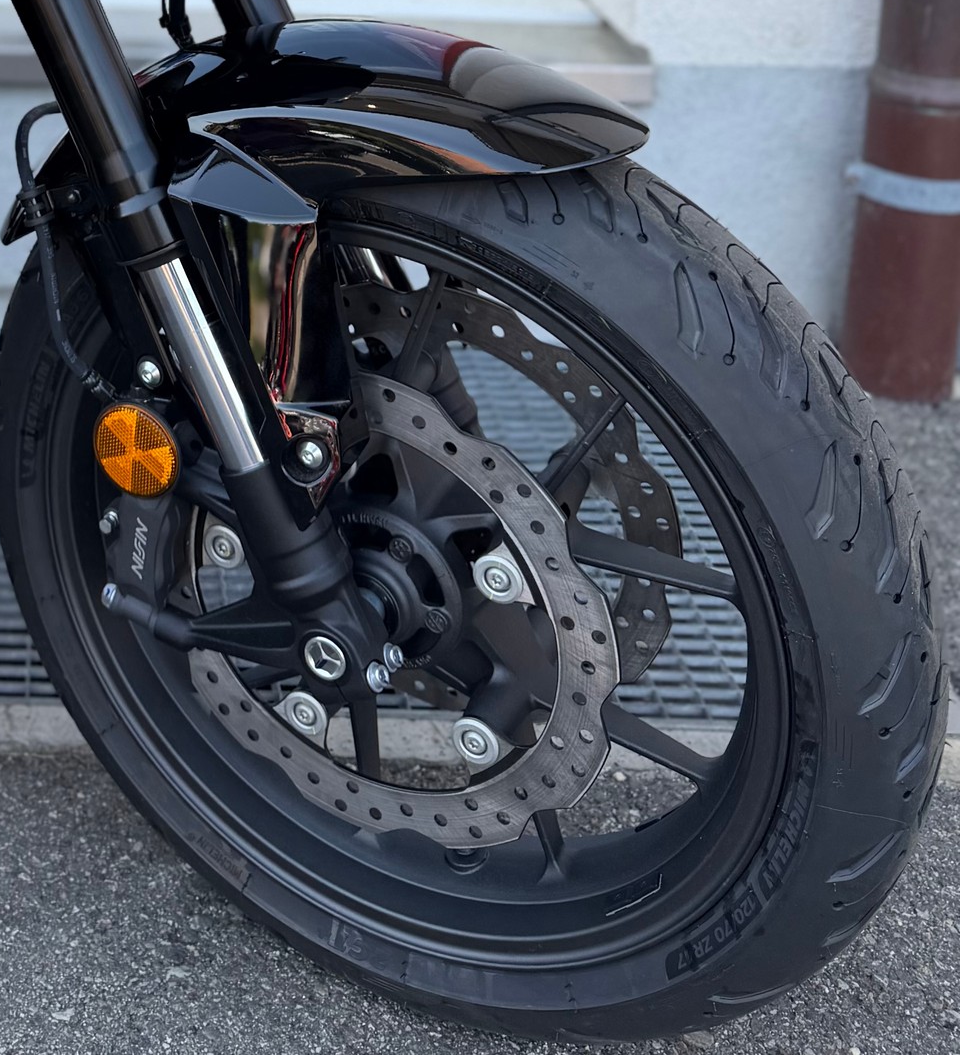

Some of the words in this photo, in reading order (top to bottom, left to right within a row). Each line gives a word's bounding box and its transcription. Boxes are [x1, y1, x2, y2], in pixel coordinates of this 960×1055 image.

[23, 362, 52, 447] MICHELIN
[763, 777, 811, 889] MICHELIN
[693, 940, 713, 959] ZR
[714, 896, 757, 943] 120/70
